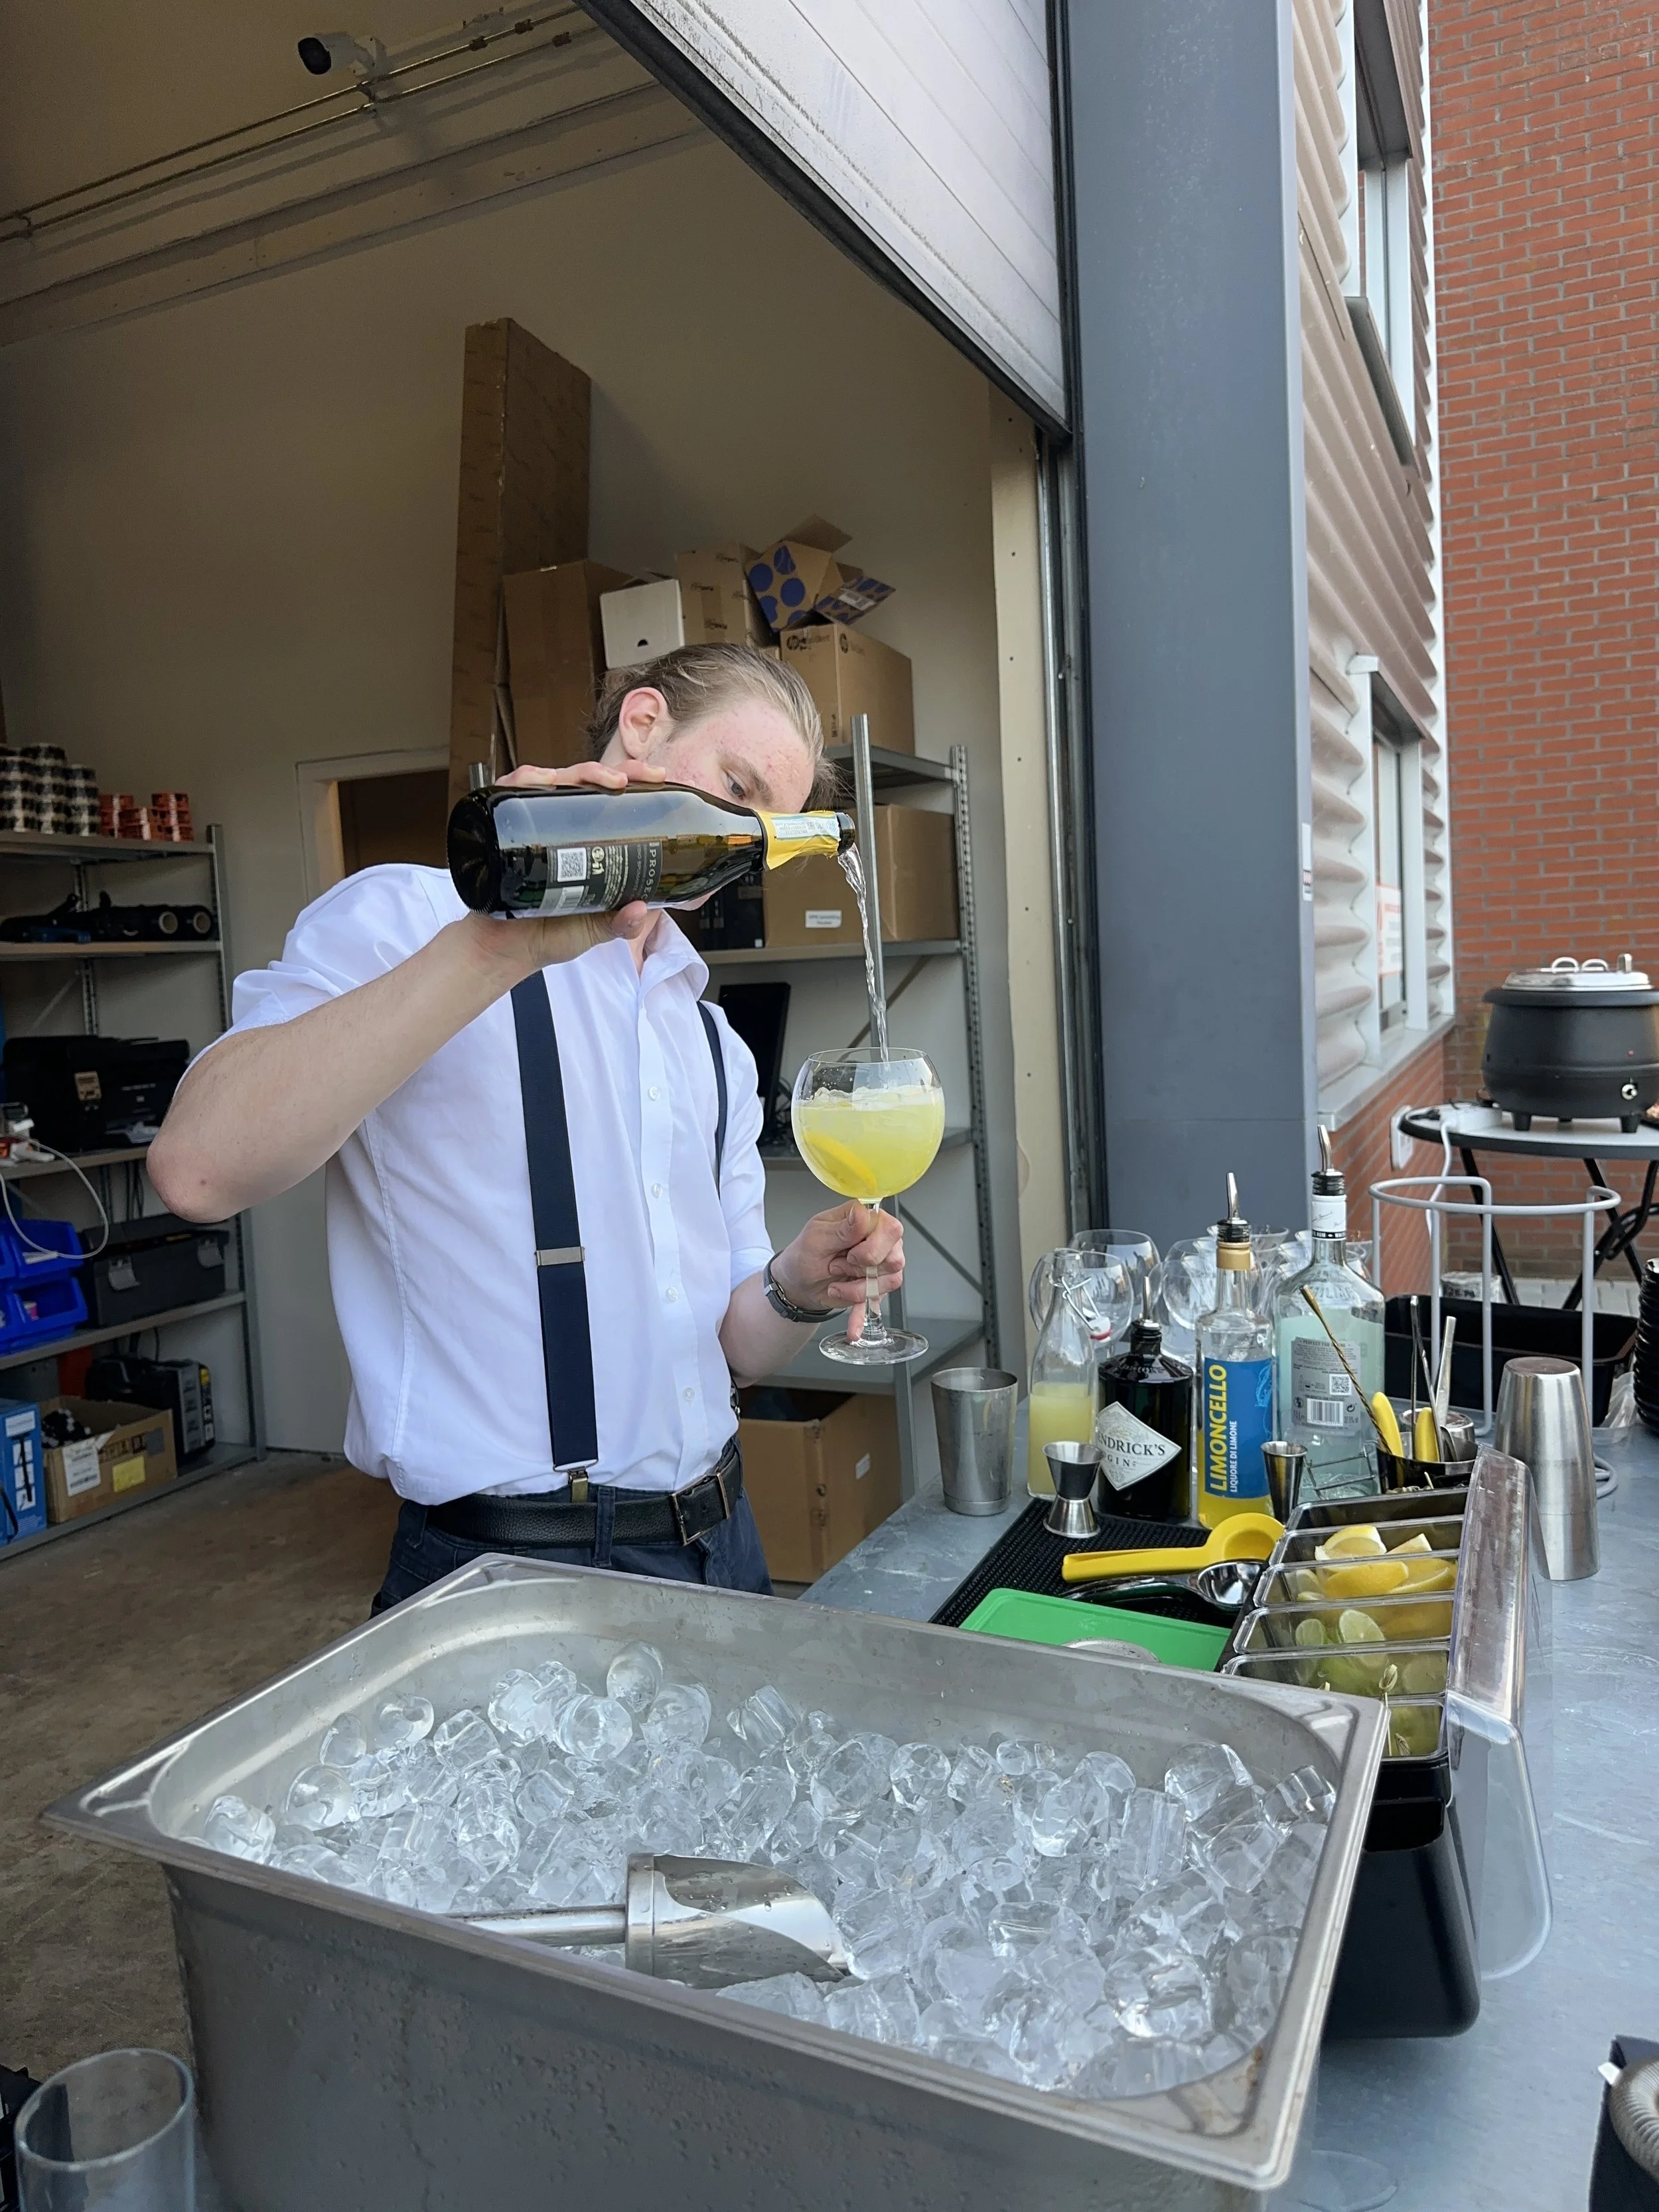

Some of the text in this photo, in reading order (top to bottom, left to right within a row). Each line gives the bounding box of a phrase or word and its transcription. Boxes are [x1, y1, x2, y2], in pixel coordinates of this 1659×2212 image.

[641, 849, 656, 899] PROSEC
[1208, 1364, 1227, 1492] LIMONCELLO
[1229, 1420, 1238, 1450] LIMONE
[1107, 1454, 1129, 1467] GIN
[1230, 1459, 1238, 1493] LIQUORE
